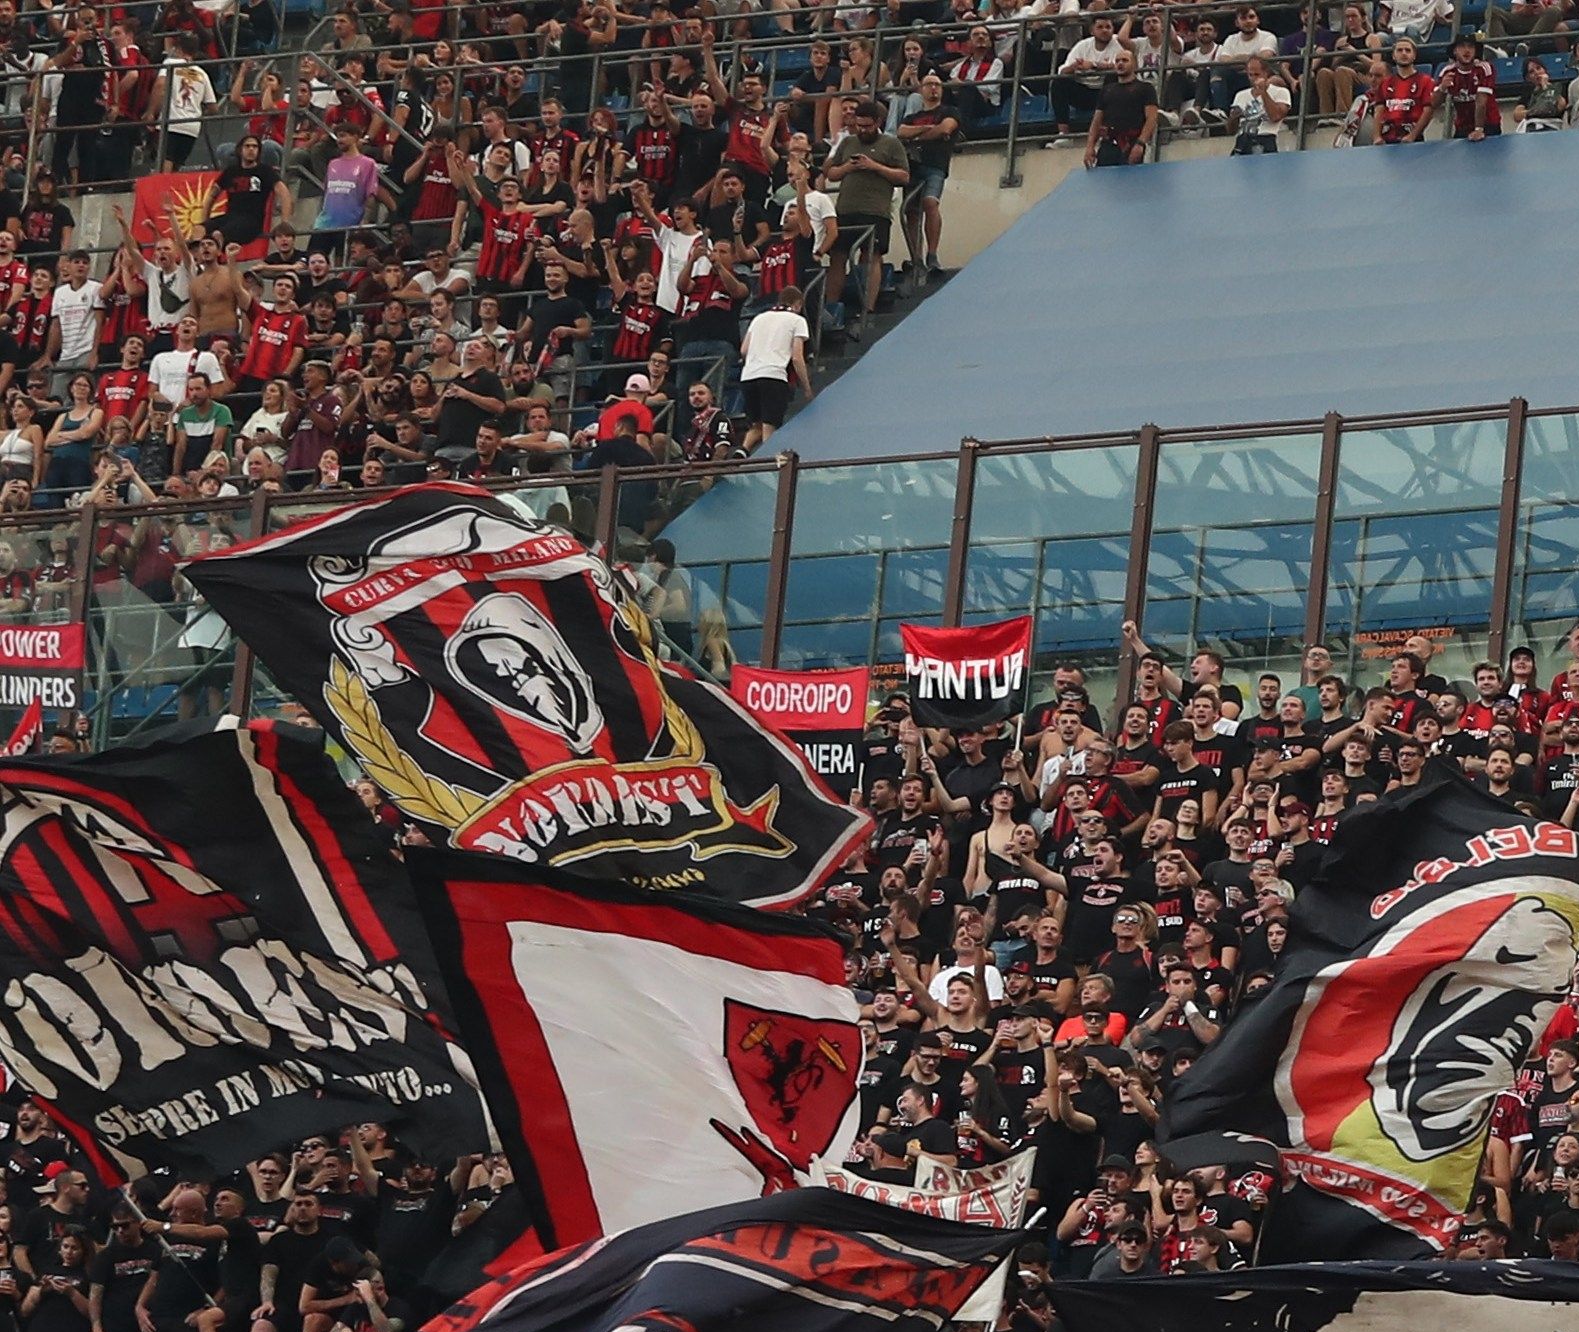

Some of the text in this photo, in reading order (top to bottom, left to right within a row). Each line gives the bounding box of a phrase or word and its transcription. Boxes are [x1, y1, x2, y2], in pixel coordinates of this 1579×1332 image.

[490, 536, 573, 567] MILANO
[0, 629, 61, 659] OWER
[746, 679, 852, 716] CODROIPO
[215, 1068, 262, 1117] IN
